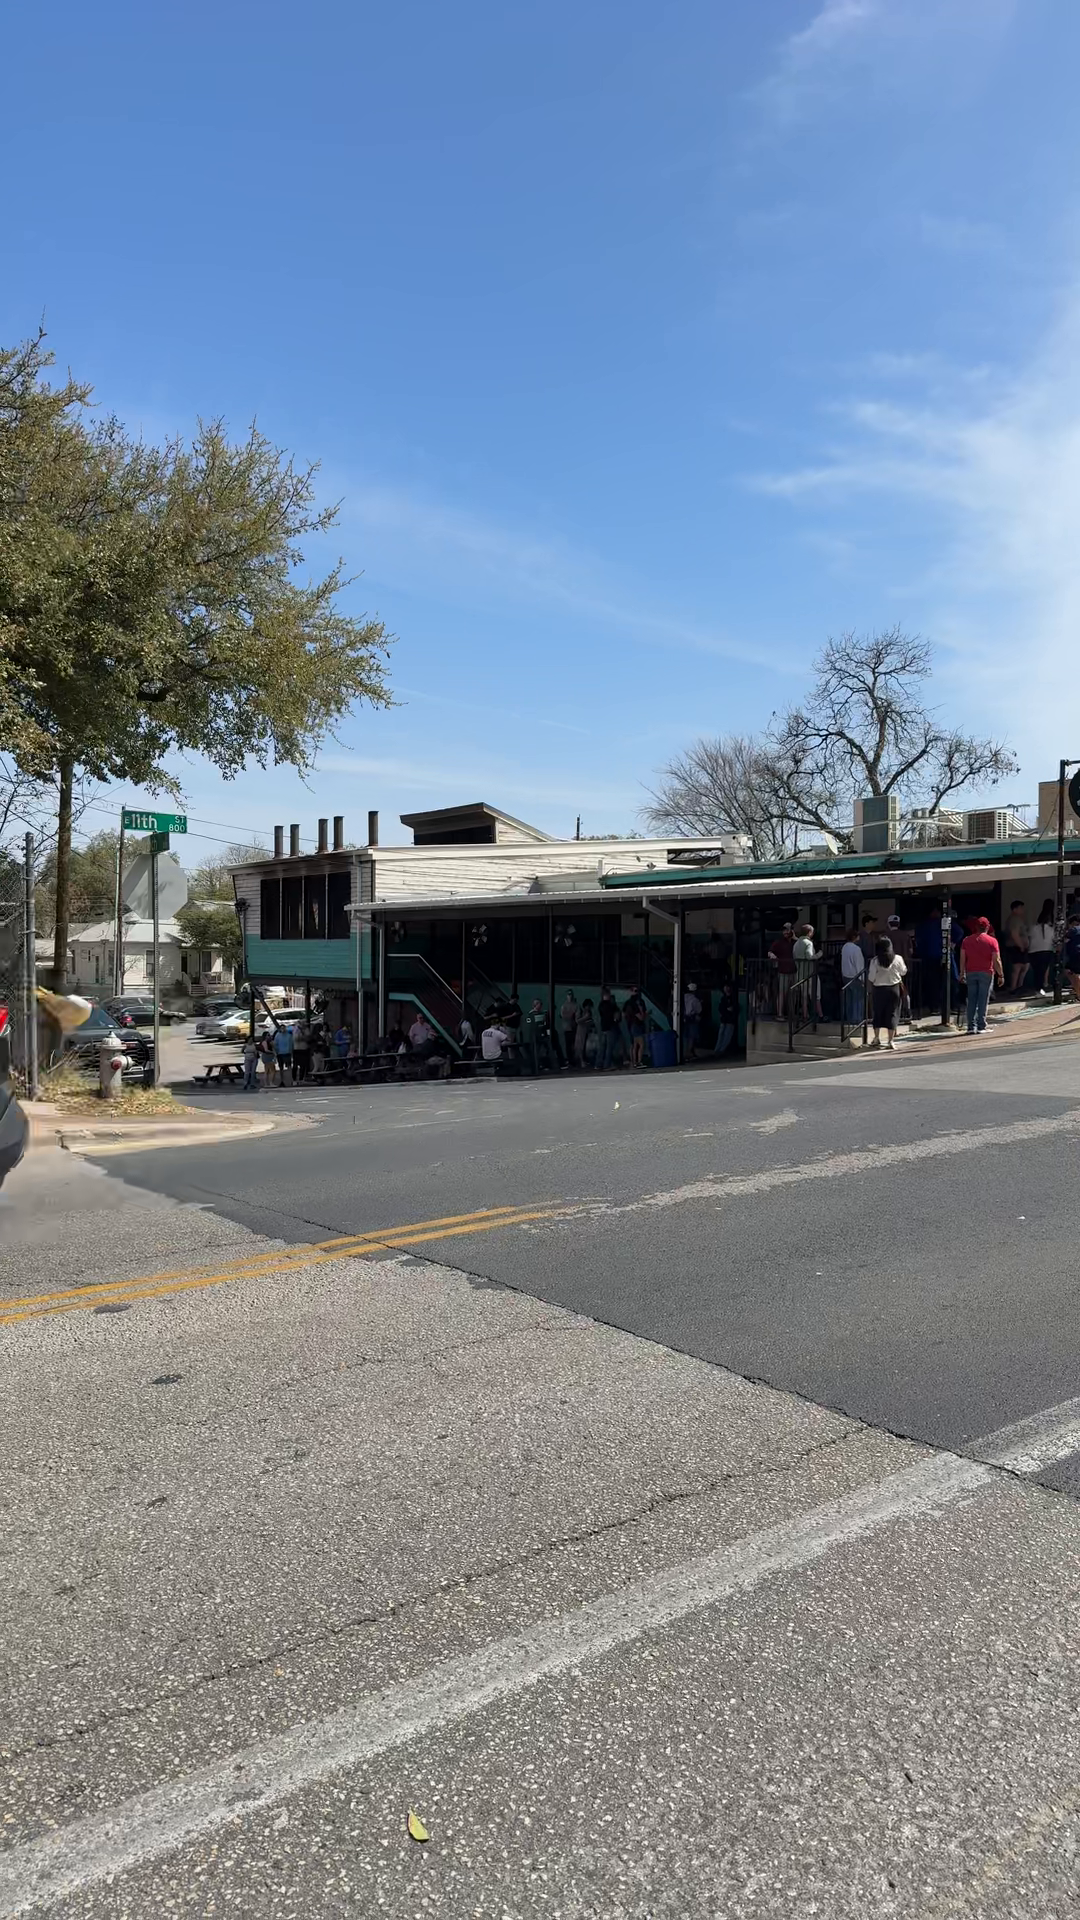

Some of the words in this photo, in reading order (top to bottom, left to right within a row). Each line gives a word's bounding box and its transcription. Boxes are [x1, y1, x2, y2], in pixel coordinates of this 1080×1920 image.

[124, 816, 130, 824] E
[132, 813, 158, 829] 11th
[174, 816, 185, 824] ST
[168, 824, 186, 832] 800
